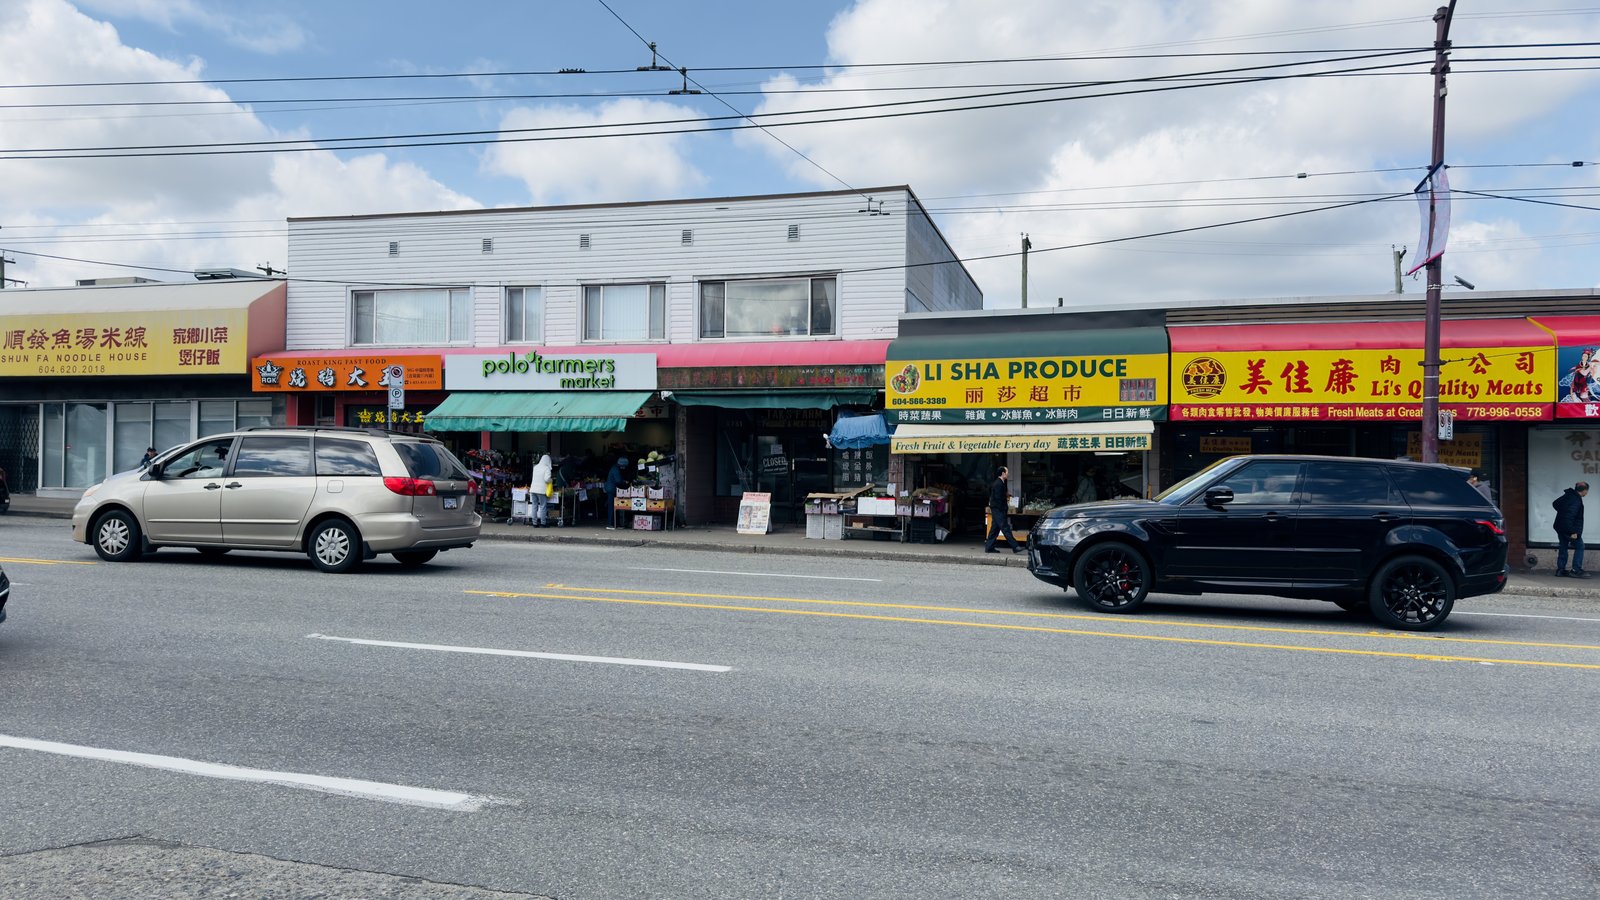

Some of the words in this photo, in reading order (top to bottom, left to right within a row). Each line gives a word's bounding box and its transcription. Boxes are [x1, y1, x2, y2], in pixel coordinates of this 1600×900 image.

[3, 326, 148, 350] 順發魚湯米線
[37, 354, 49, 362] FA
[56, 354, 101, 362] NOODLE
[110, 352, 148, 362] HOUSE
[179, 349, 220, 366] 煲仔飯
[482, 352, 529, 377] polo
[534, 354, 615, 373] farmers
[39, 365, 105, 374] 604.620.2018
[924, 364, 942, 381] LI
[950, 362, 1000, 380] SHA
[1008, 358, 1127, 379] PRODUCE
[1239, 358, 1359, 395] 美佳廉
[1380, 352, 1534, 375] 肉公司
[560, 373, 615, 388] market
[965, 384, 1082, 404] 丽莎超市
[1371, 380, 1402, 396] Li's
[1408, 379, 1479, 399] Qality
[1486, 380, 1543, 395] Meats
[1001, 409, 1033, 420] 冰鮮魚
[1045, 408, 1078, 419] 冰鮮肉
[1102, 408, 1151, 419] 日日新鮮
[1328, 407, 1353, 417] Fresh
[1355, 407, 1383, 417] Meats
[1387, 407, 1395, 417] at
[1466, 407, 1542, 417] 778-996-0558
[895, 442, 919, 450] Fresh
[922, 441, 945, 450] Fruit
[948, 442, 956, 450] &
[959, 440, 1001, 451] Vegetable
[1004, 440, 1030, 450] Every
[1033, 440, 1051, 450] day
[1105, 436, 1147, 448] 日日新鮮
[762, 456, 786, 468] CLOSED
